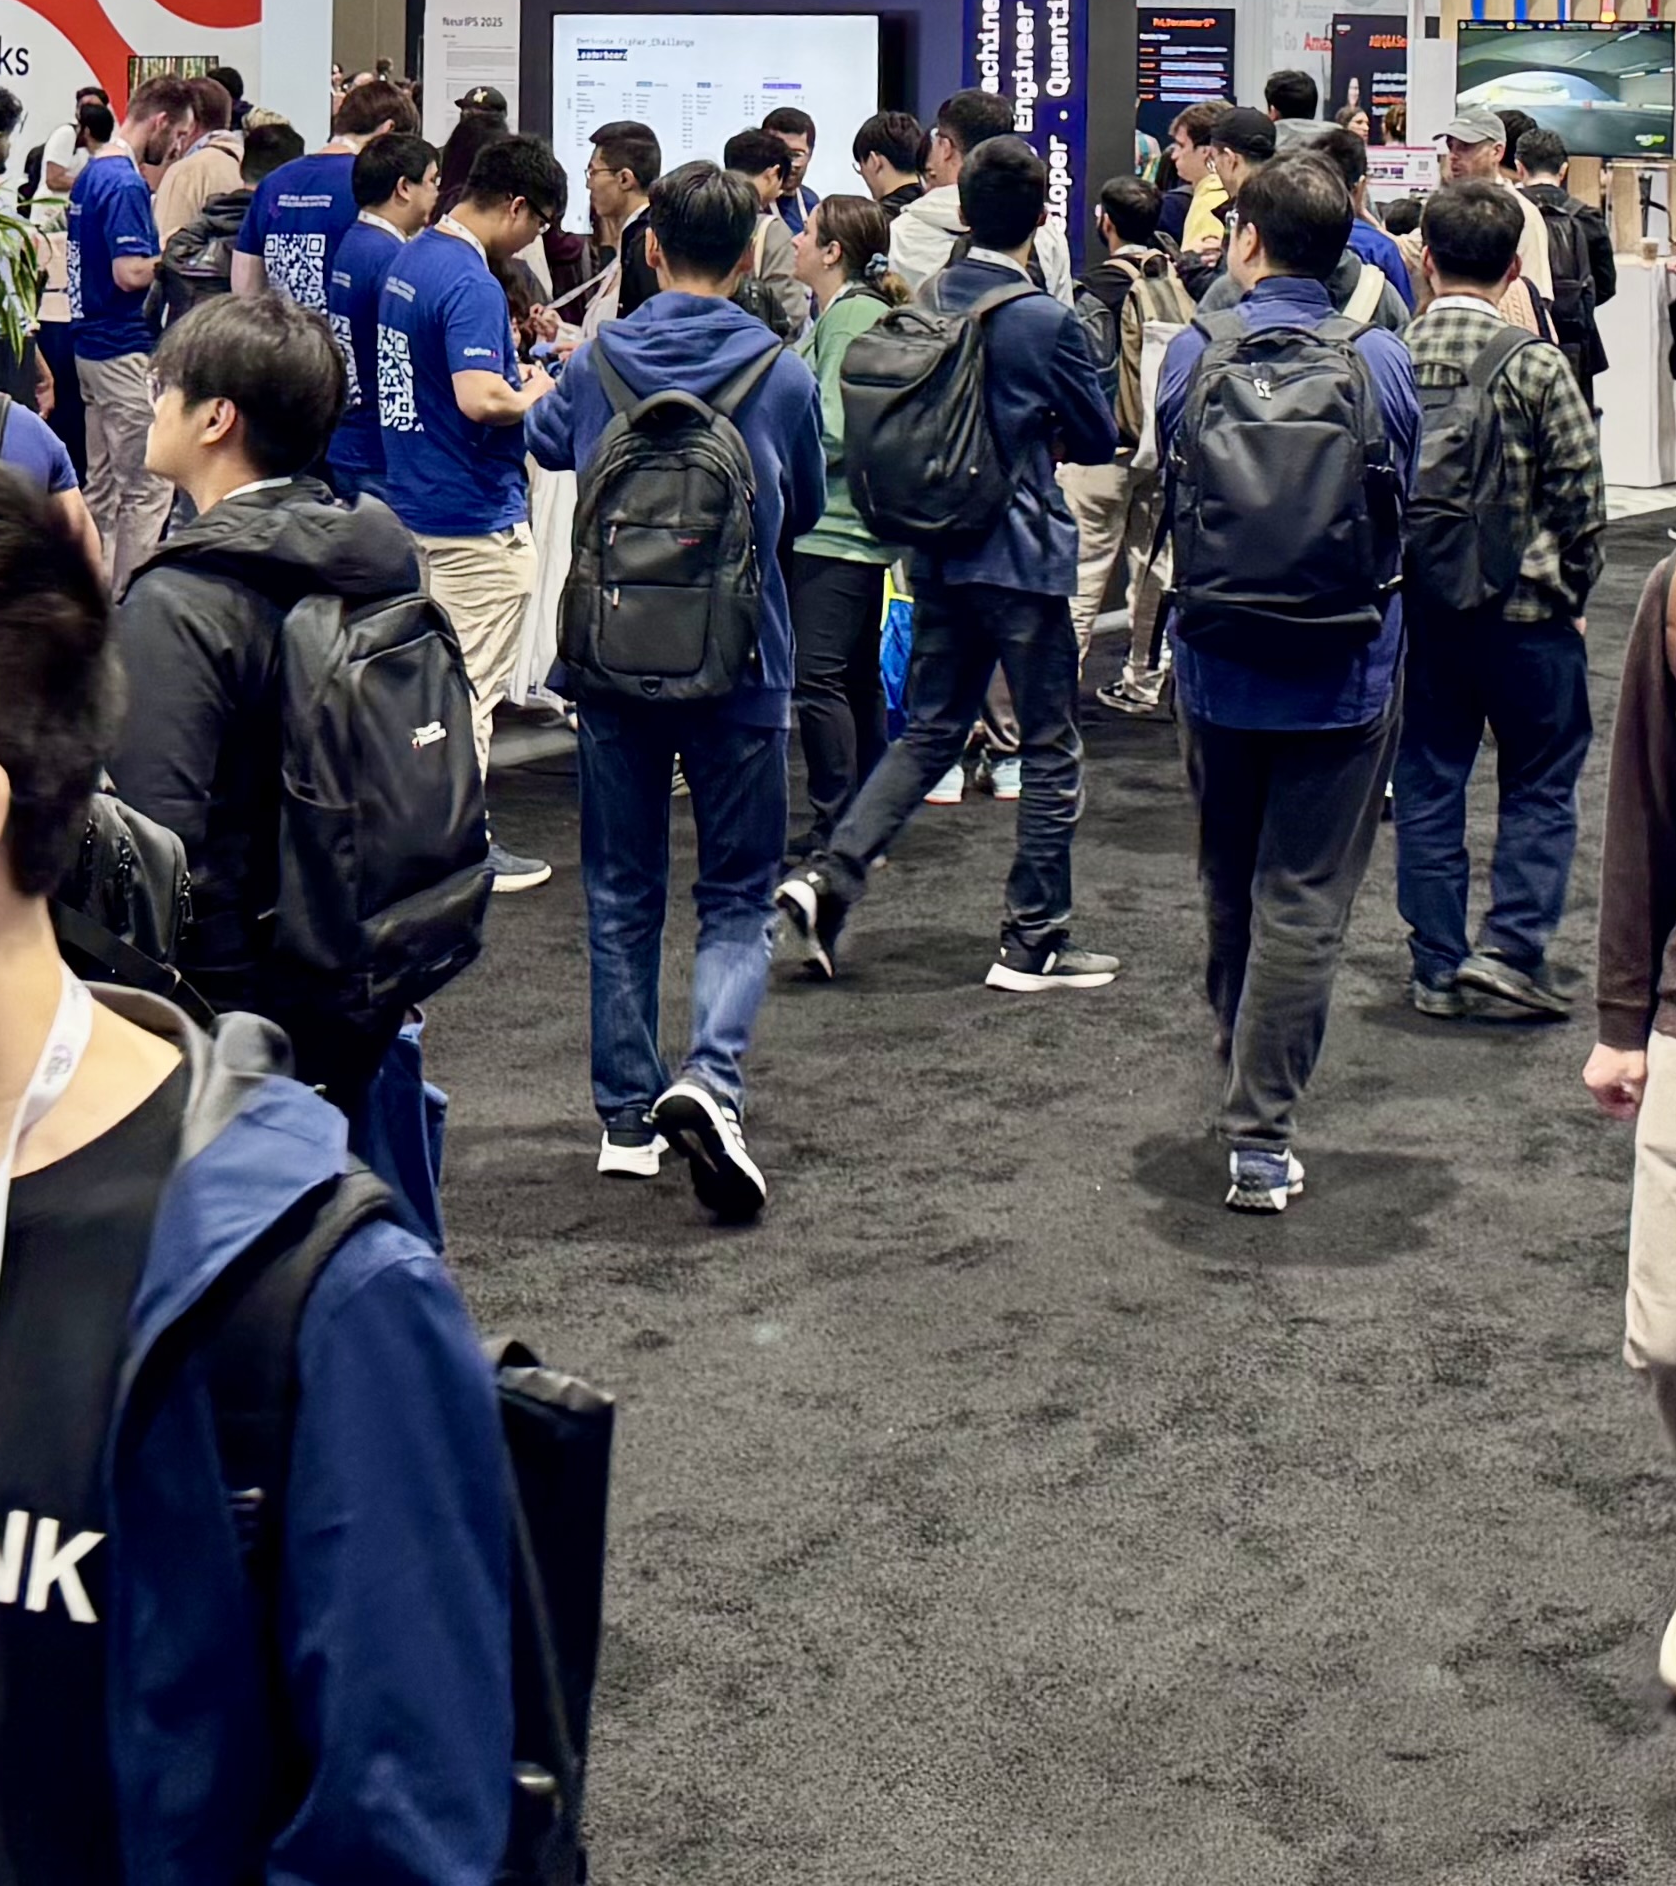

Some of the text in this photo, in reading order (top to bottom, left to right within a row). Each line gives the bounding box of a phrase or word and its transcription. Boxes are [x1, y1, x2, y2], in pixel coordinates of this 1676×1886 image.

[442, 17, 503, 27] NeurIPS 2025
[1012, 1, 1038, 132] Engineer
